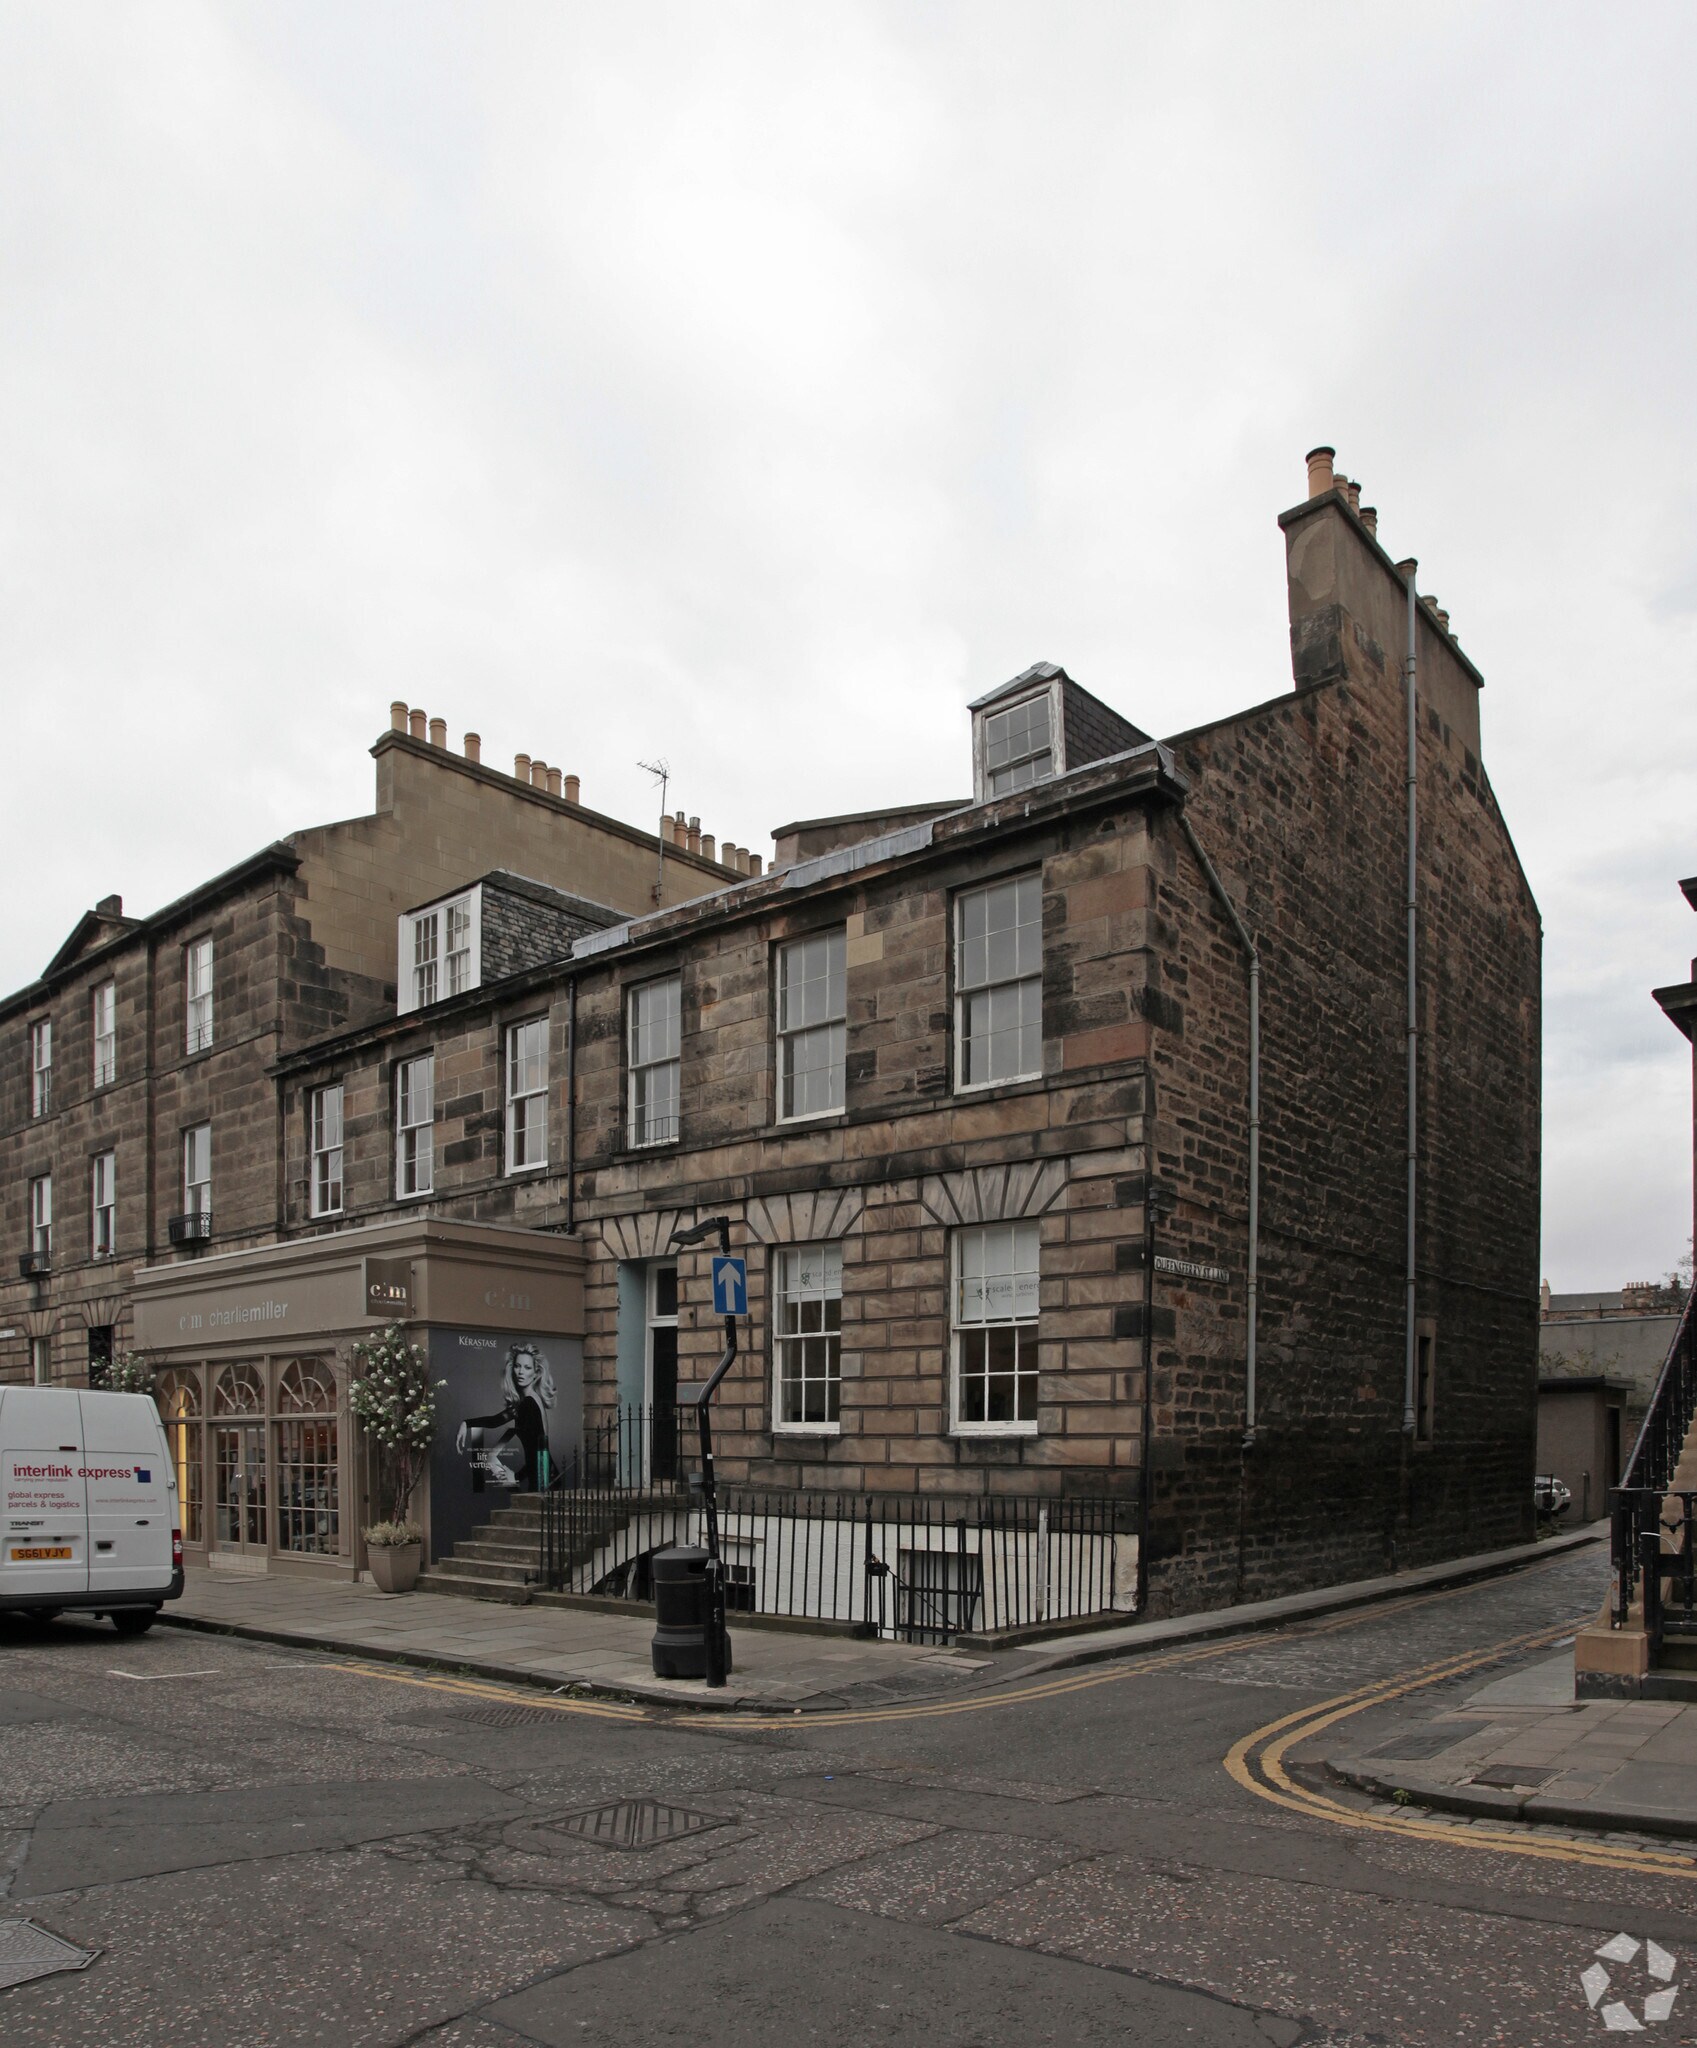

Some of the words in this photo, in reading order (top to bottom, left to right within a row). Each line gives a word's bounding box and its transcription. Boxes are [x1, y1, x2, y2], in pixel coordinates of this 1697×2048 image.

[209, 1300, 288, 1327] charliemiller
[13, 1464, 73, 1477] interlink
[78, 1467, 131, 1480] express
[8, 1491, 32, 1500] global
[34, 1492, 65, 1500] express
[8, 1501, 38, 1509] parcels
[49, 1501, 80, 1509] logistics
